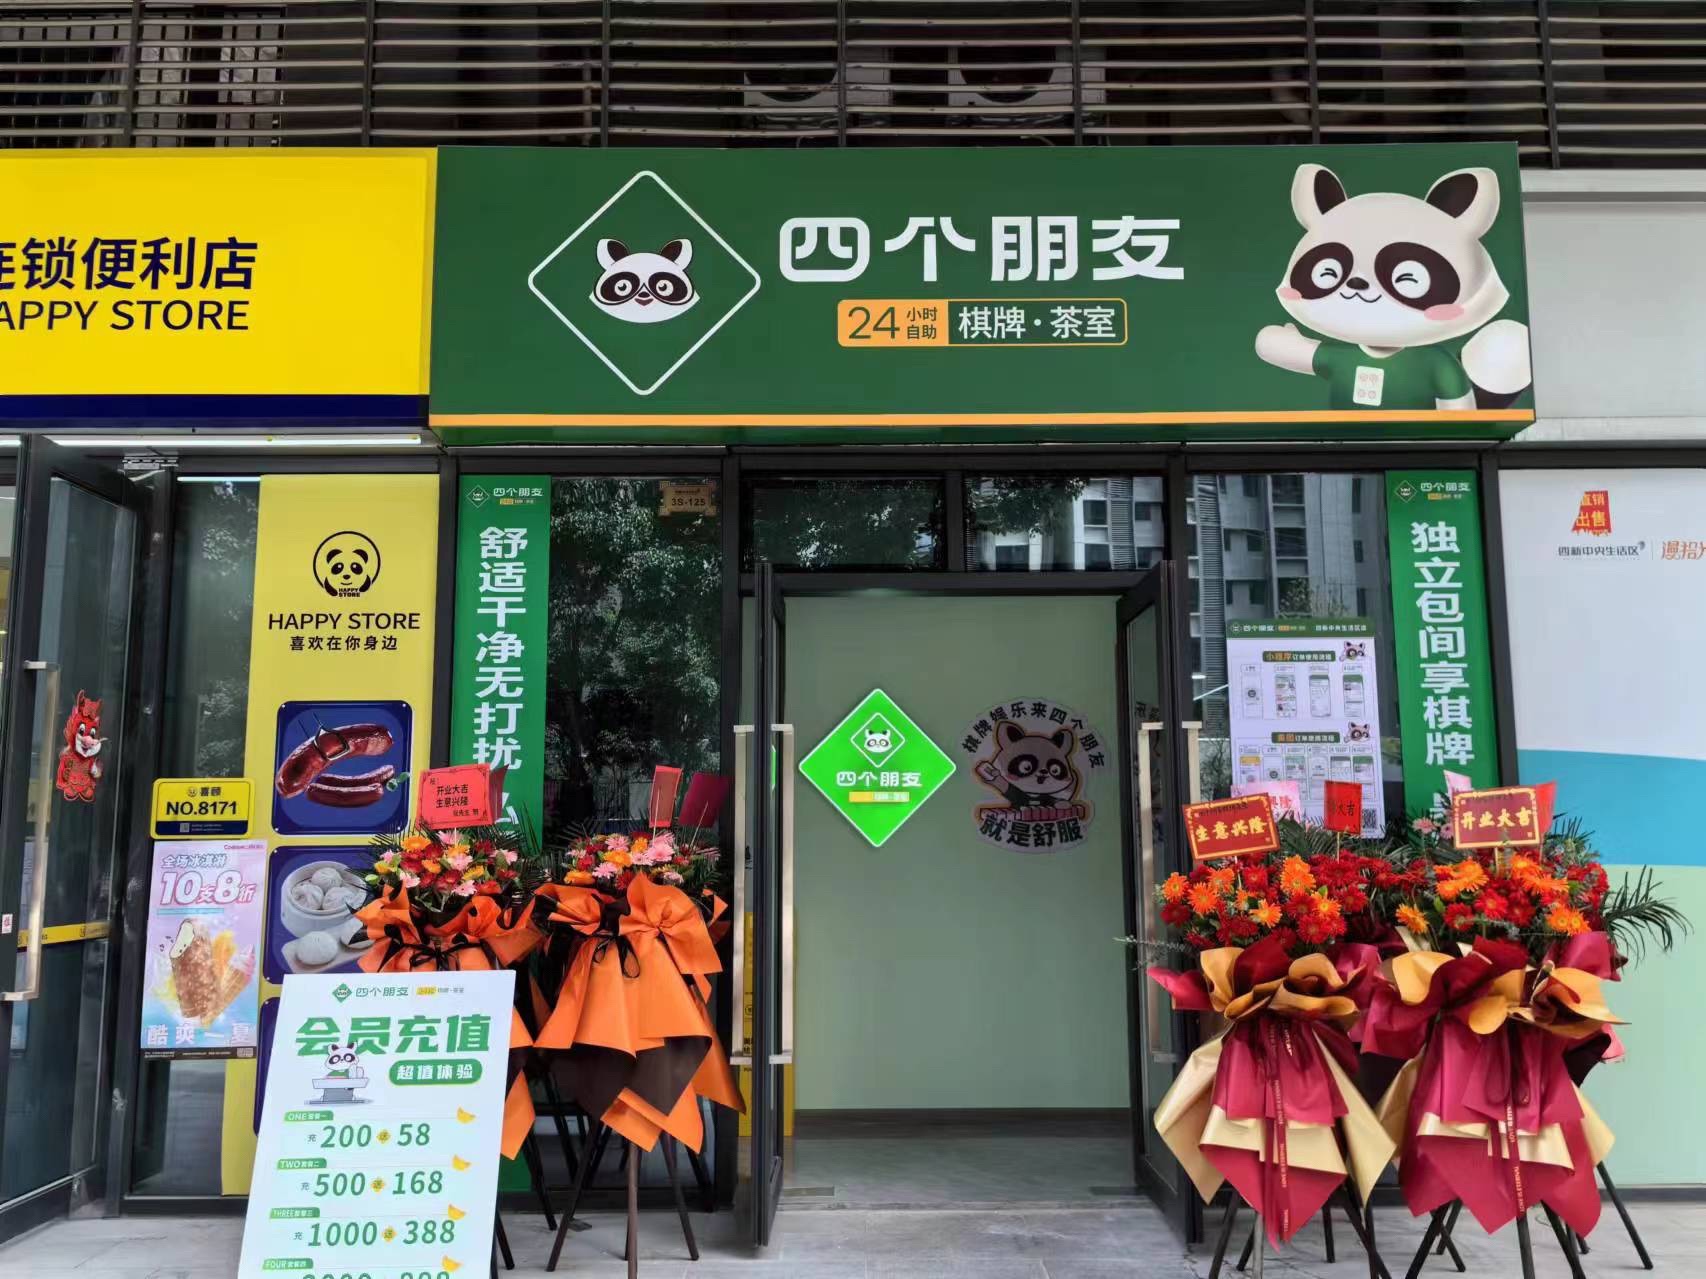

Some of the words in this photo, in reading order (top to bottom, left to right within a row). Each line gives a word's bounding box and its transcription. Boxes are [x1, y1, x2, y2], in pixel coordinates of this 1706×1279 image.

[779, 215, 1184, 282] 四个朋友
[110, 300, 250, 330] STORE
[848, 306, 900, 340] 24
[906, 307, 938, 322] 小时
[906, 324, 938, 340] 自助
[493, 487, 544, 497] 四个朋友
[1420, 482, 1471, 492] 四个朋友
[672, 498, 706, 506] 3S-125
[1575, 510, 1606, 527] 出售
[1558, 545, 1639, 556] 四新中央生活区
[268, 613, 342, 630] HAPPY
[348, 613, 421, 630] STORE
[290, 635, 398, 651] 喜欢在你身边
[962, 701, 1105, 769] 棋牌娱乐来四个朋友
[836, 771, 923, 788] 四个朋友
[437, 784, 469, 796] 开业大吉
[166, 801, 237, 816] NO.8171
[436, 796, 469, 809] 生意兴隆
[1460, 806, 1532, 831] 开业大吉
[980, 813, 1083, 848] 就是舒服
[1195, 815, 1268, 843] 生意兴隆
[355, 986, 409, 997] 四个朋友
[296, 1013, 492, 1057] 会员充值
[396, 1064, 473, 1081] 超值体验
[320, 1124, 372, 1149] 200
[397, 1122, 431, 1147] 58
[313, 1172, 366, 1197] 500
[392, 1170, 443, 1195] 168
[308, 1221, 378, 1248] 1000
[403, 1219, 456, 1245] 388
